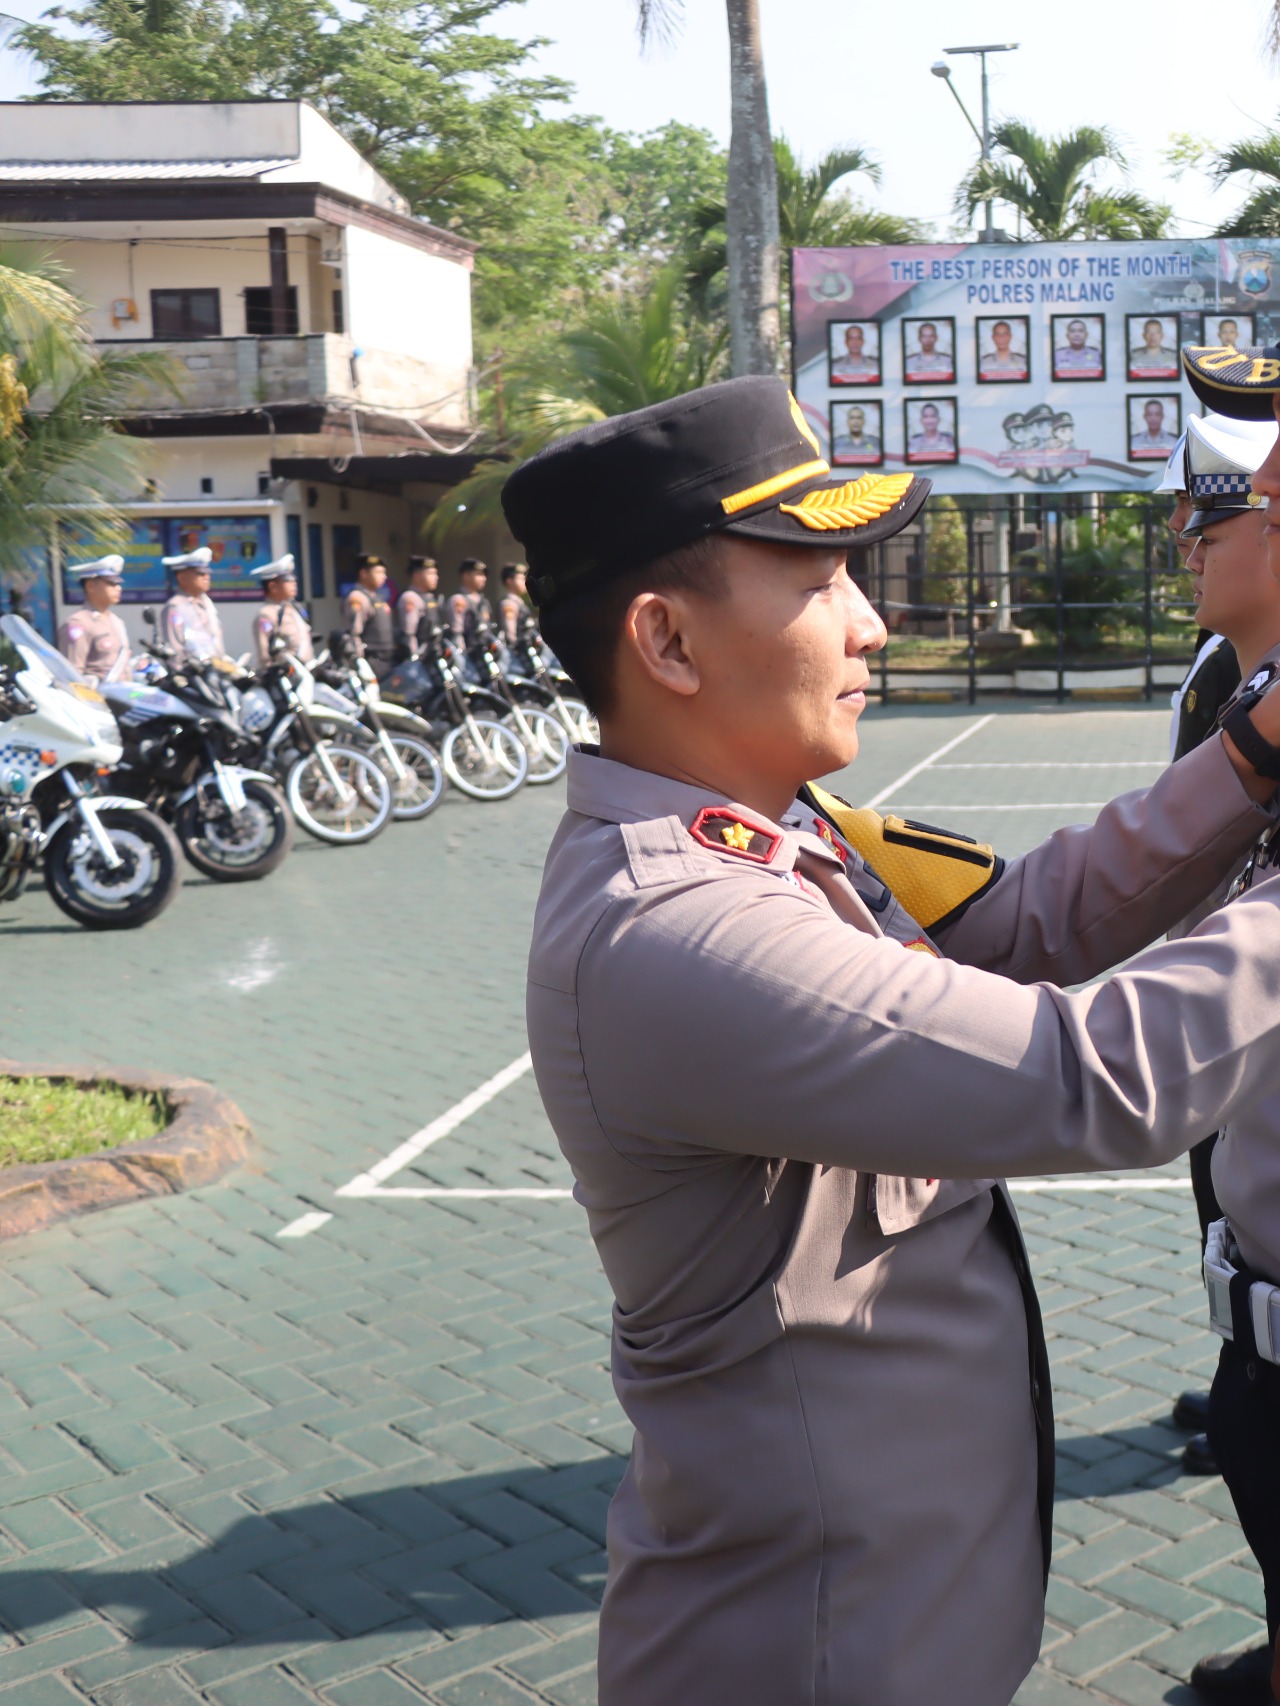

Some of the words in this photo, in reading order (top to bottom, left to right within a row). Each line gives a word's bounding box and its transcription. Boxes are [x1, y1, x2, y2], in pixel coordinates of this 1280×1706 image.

[891, 261, 924, 280] THE
[931, 260, 975, 279] BEST
[982, 259, 1051, 278] PERSON
[1058, 258, 1080, 277] OF
[1087, 257, 1120, 277] THE
[1127, 256, 1190, 276] MONTH
[968, 284, 1034, 303] POLRES
[1041, 283, 1114, 303] MALANG
